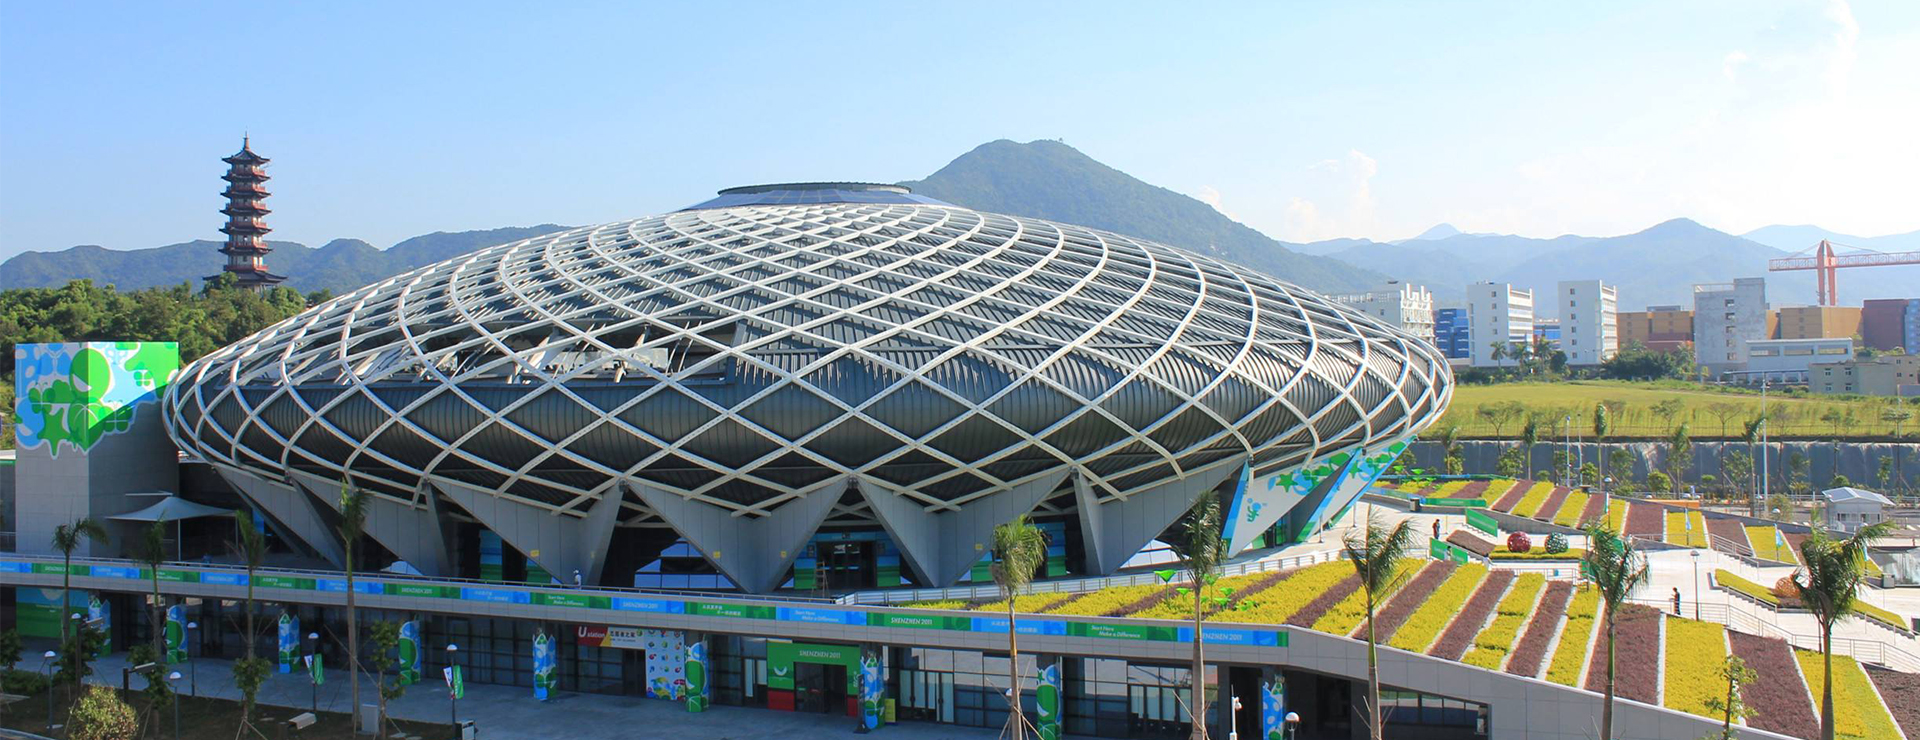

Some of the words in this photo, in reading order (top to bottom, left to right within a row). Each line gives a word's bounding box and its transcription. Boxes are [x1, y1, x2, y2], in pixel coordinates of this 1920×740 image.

[578, 626, 587, 638] U
[799, 650, 829, 658] SHENZHEN
[829, 651, 841, 659] 2011
